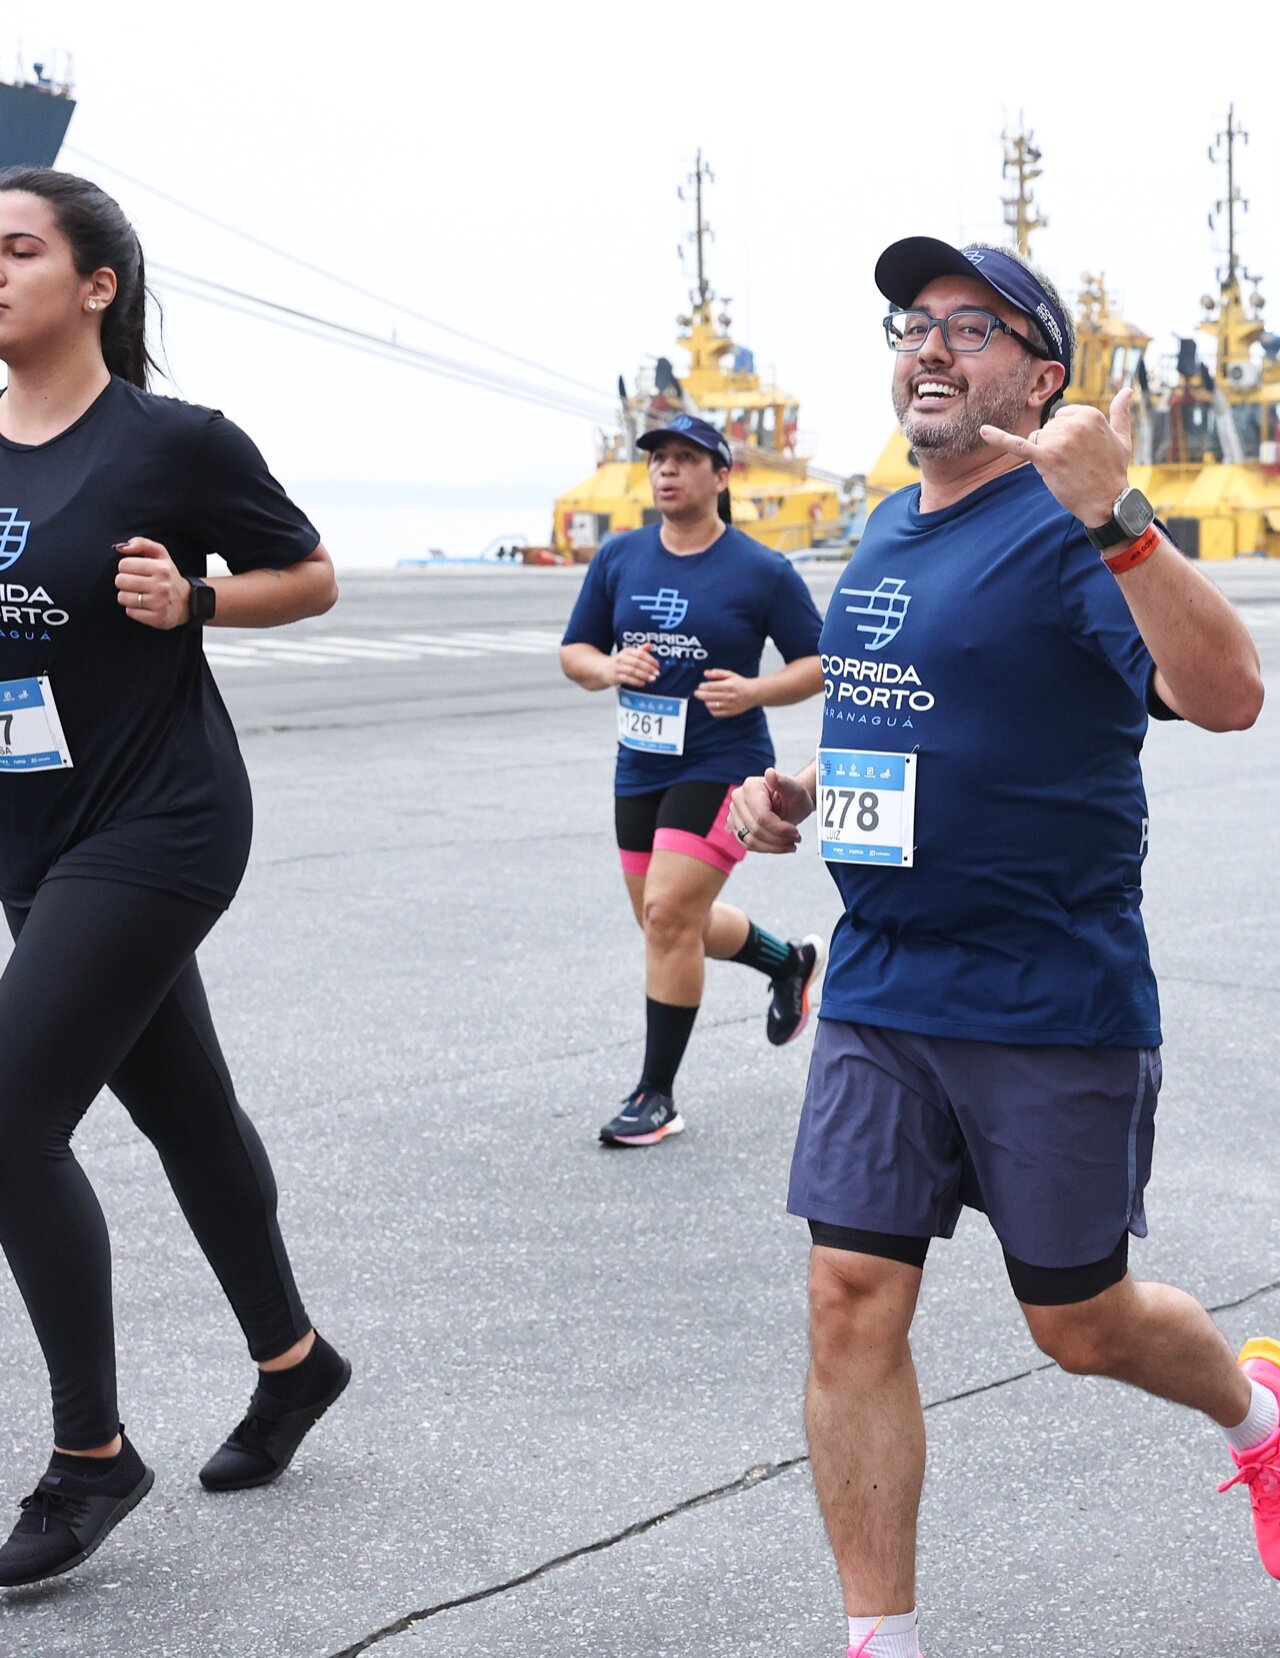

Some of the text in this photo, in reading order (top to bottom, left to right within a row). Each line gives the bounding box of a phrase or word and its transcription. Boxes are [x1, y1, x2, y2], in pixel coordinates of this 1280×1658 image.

[0, 605, 70, 626] RTO
[622, 631, 702, 648] CORRIDA
[820, 653, 923, 686] CORRIDA
[824, 679, 935, 712] O PORTO
[824, 706, 914, 729] ARANAGUÁ
[821, 788, 880, 832] 278
